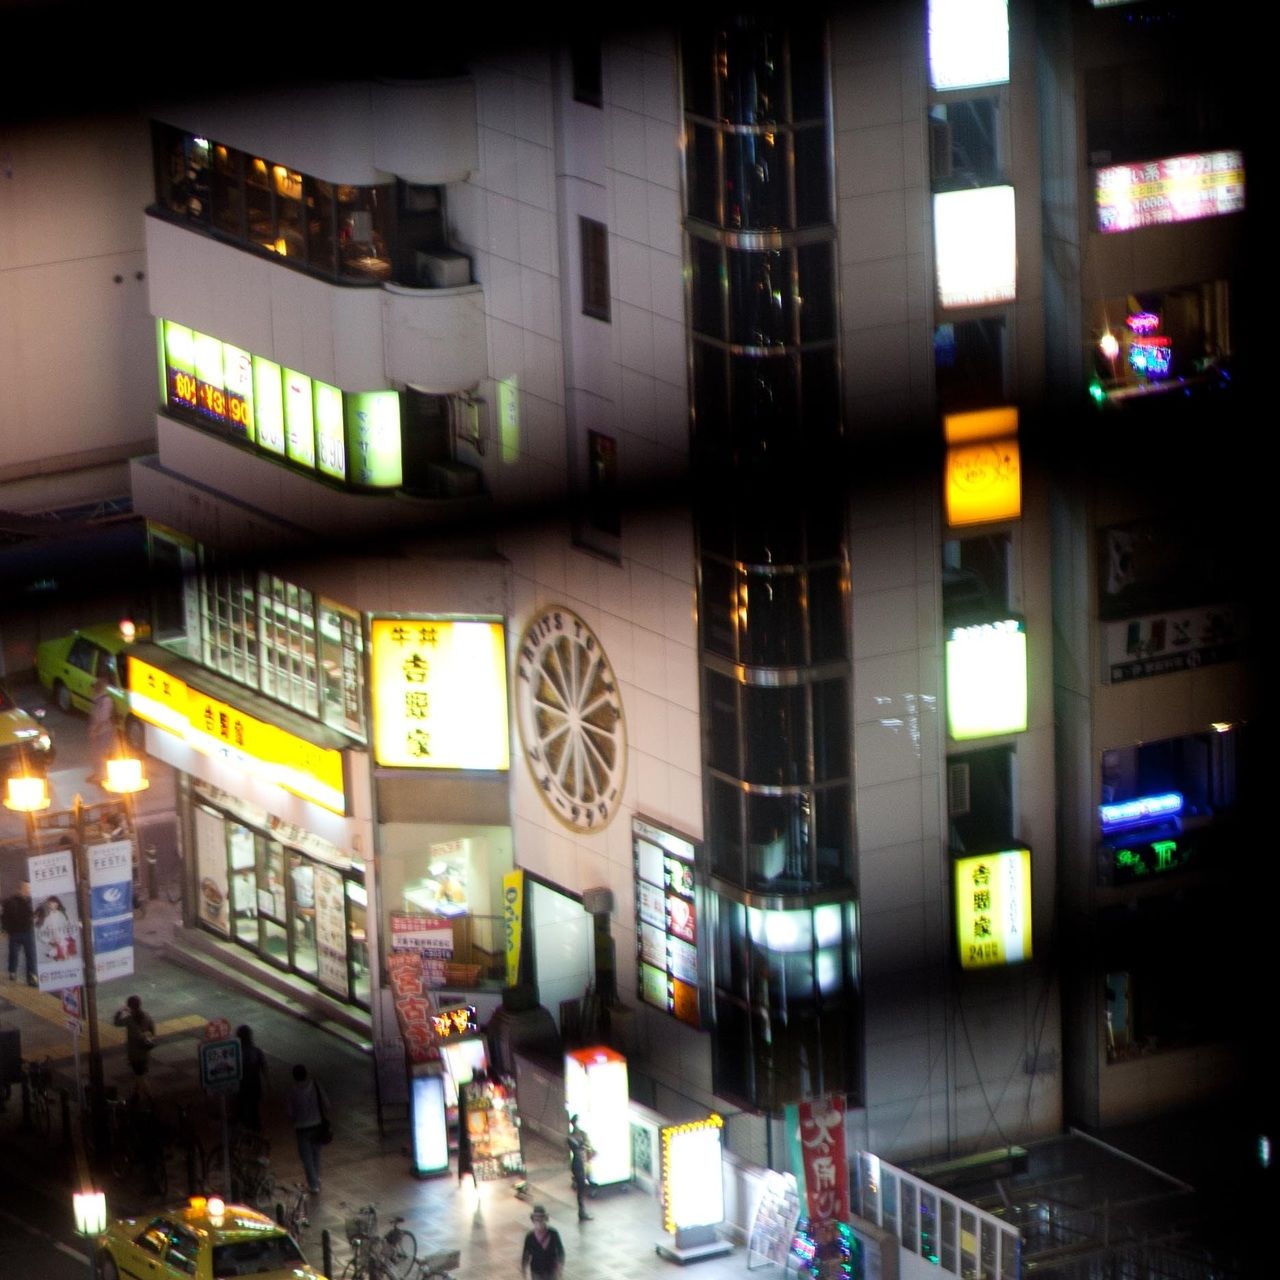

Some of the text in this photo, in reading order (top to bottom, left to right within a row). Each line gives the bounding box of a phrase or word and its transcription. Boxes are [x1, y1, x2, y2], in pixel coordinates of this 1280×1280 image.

[520, 613, 564, 684] FRUITS
[94, 856, 128, 868] FESTA
[34, 865, 68, 879] FESTA
